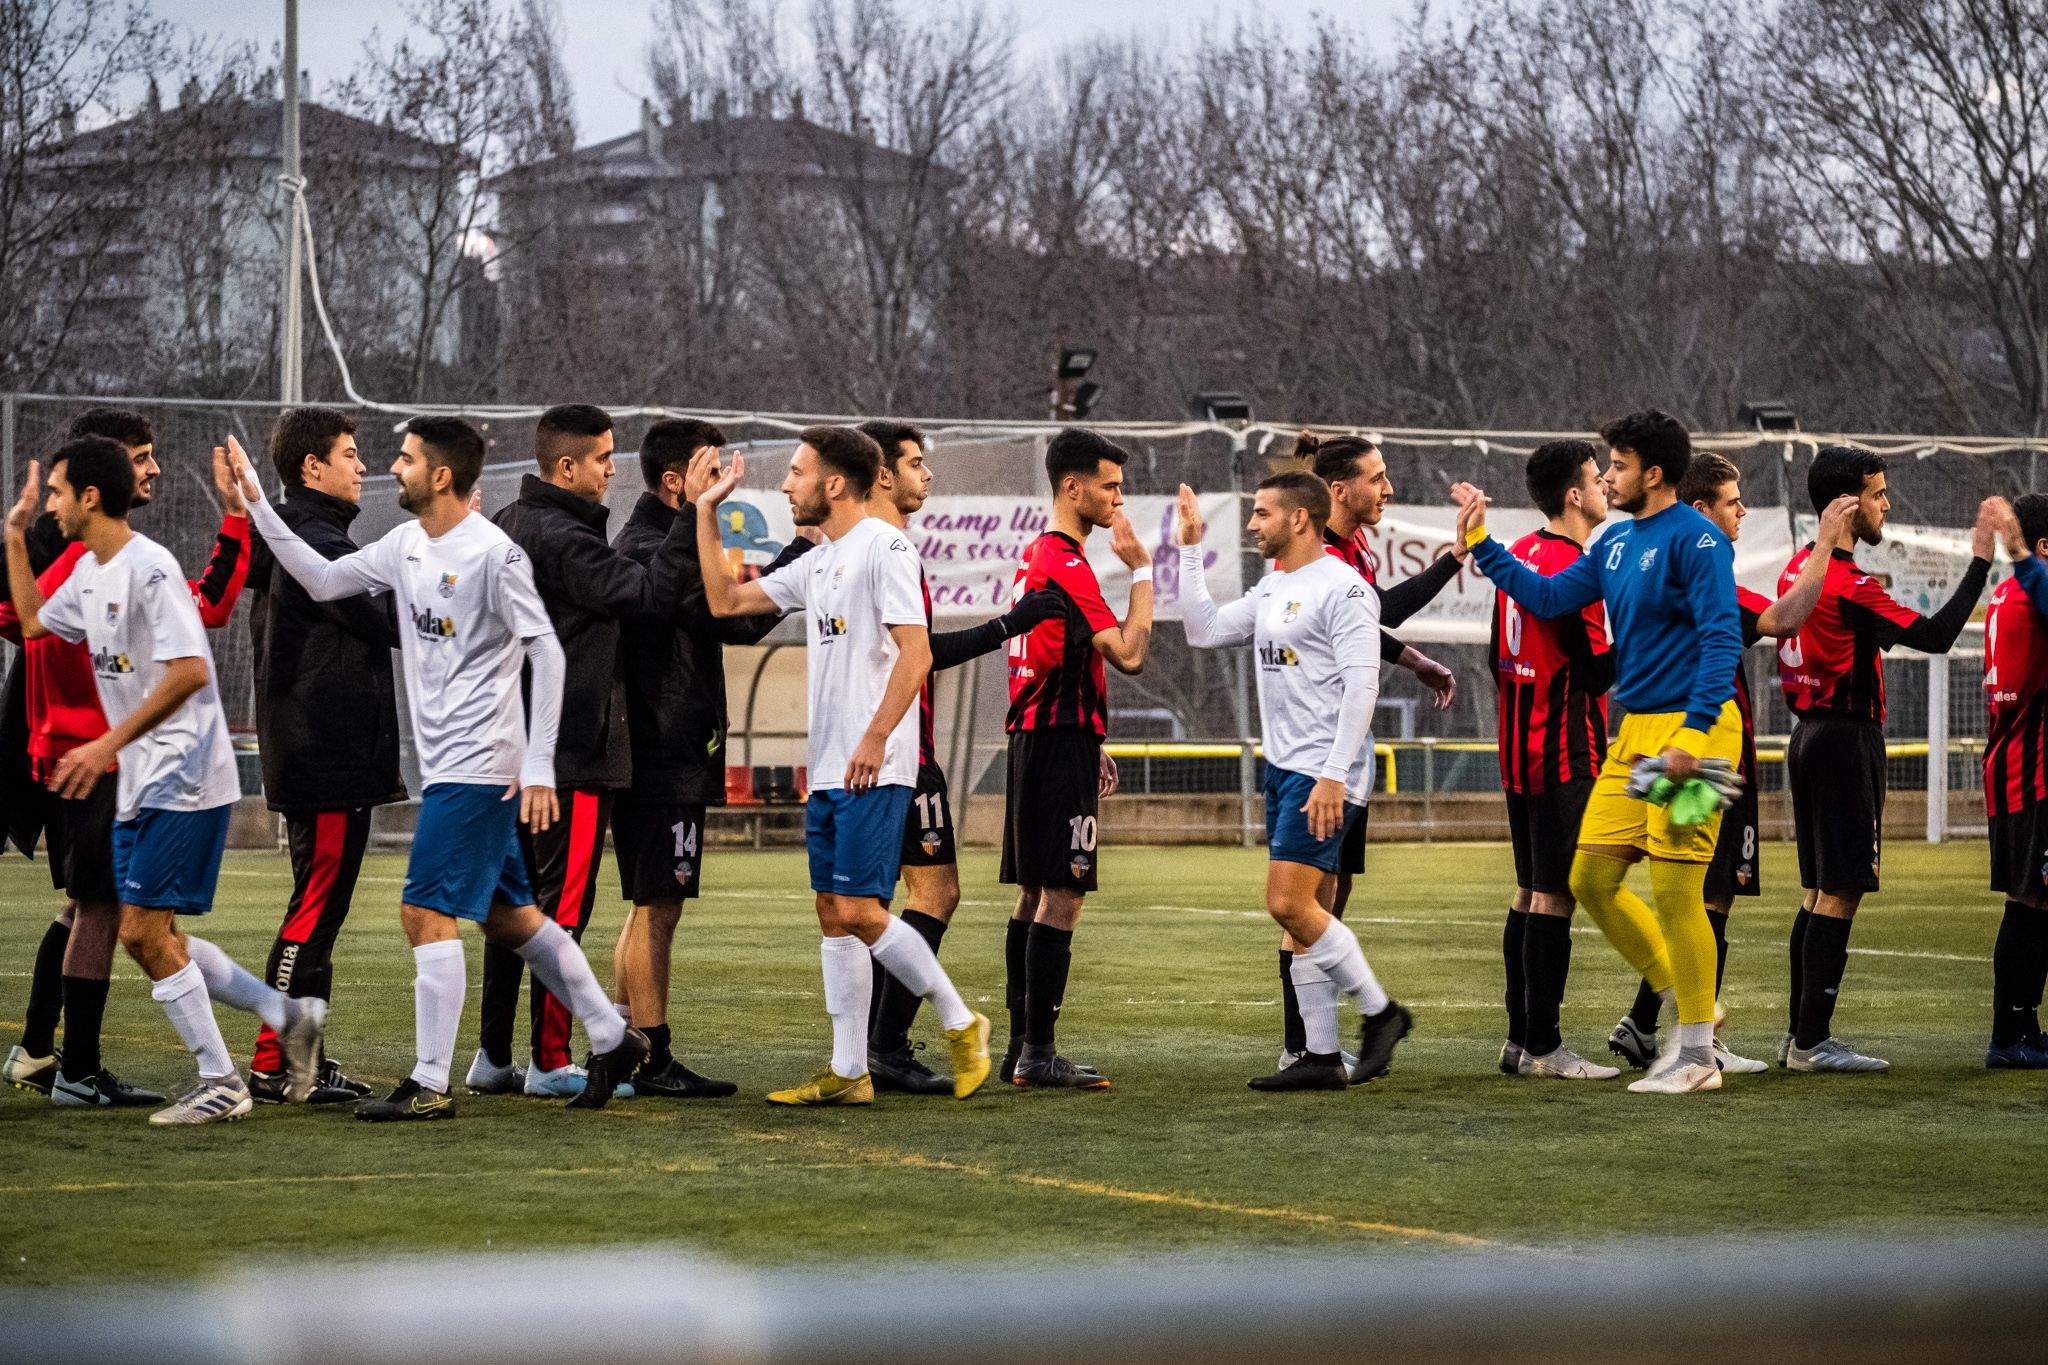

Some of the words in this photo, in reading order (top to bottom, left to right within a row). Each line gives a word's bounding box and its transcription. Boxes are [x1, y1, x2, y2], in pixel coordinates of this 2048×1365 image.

[922, 513, 1001, 540] camp
[914, 792, 944, 829] 11
[671, 821, 697, 857] 14
[1069, 814, 1097, 852] 10
[1742, 825, 1755, 860] 8
